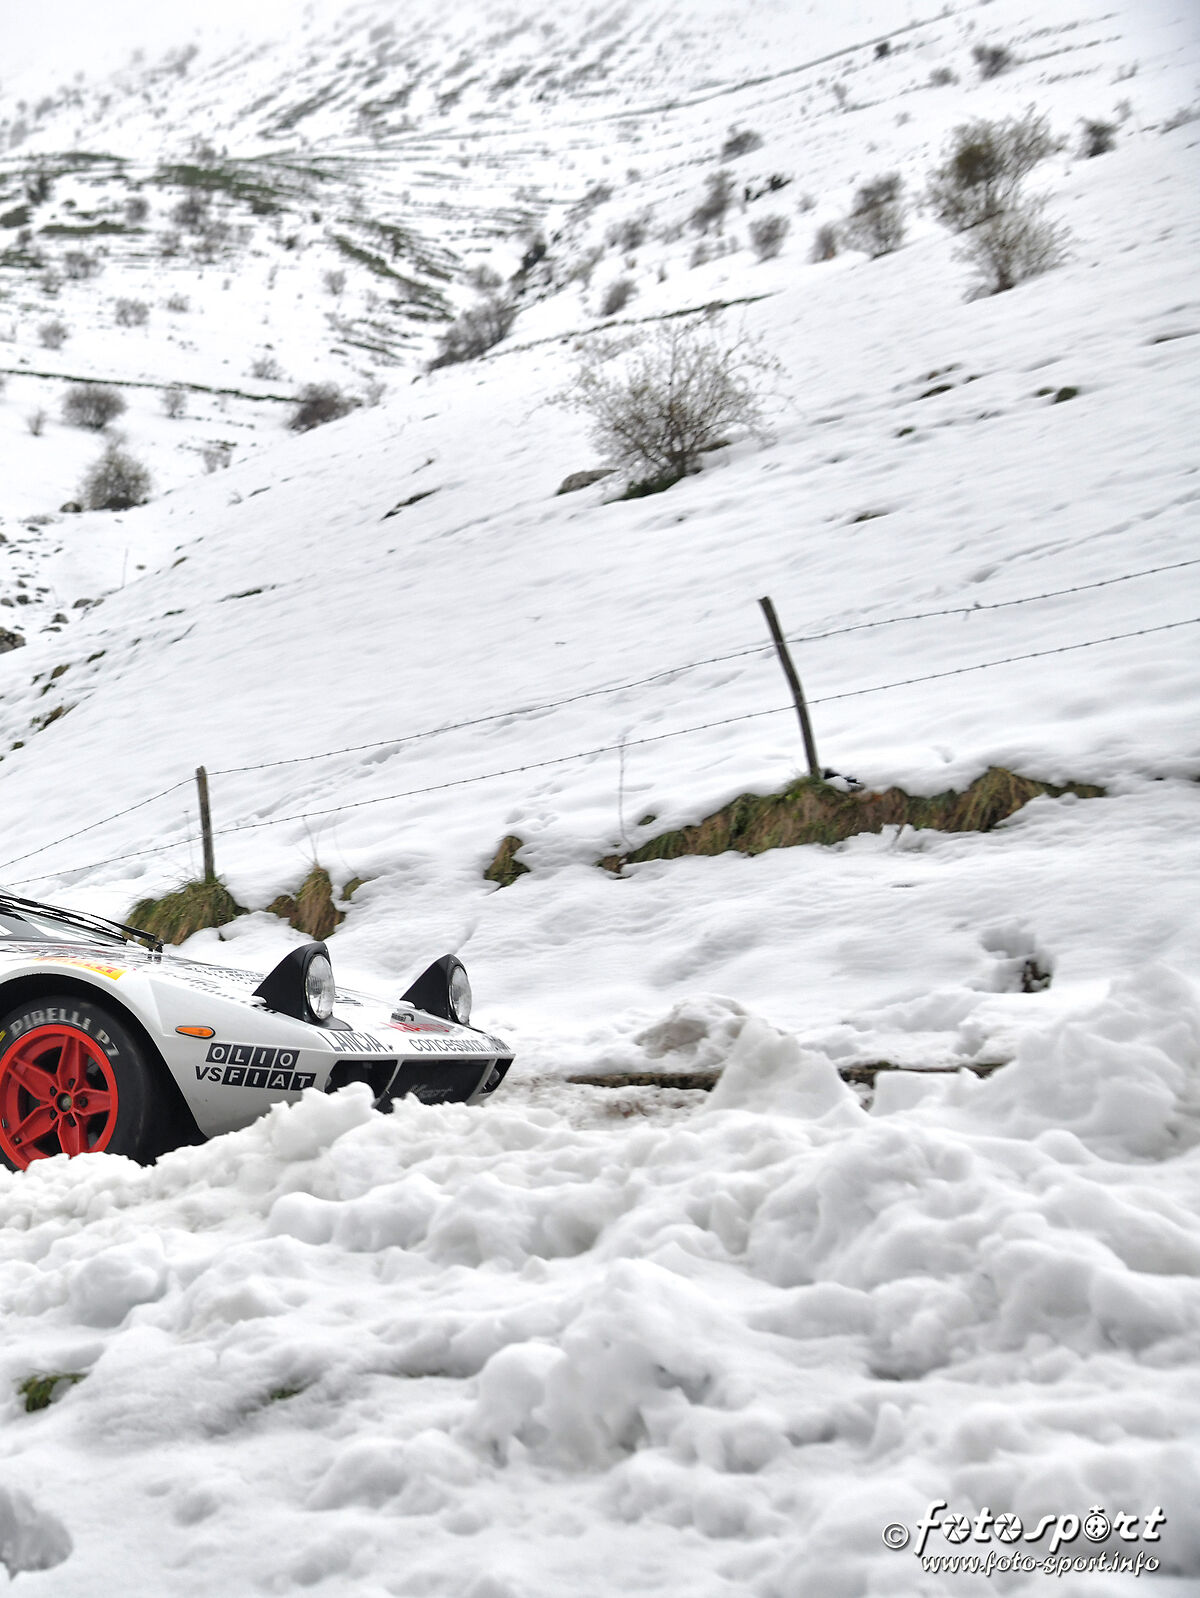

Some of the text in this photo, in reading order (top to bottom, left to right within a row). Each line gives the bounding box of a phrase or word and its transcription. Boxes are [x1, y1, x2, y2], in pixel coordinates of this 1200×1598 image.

[9, 1006, 92, 1035] PIRELLI
[317, 1031, 388, 1053] LANCIA
[211, 1046, 294, 1067] OLIO
[195, 1065, 312, 1088] VS FIAT
